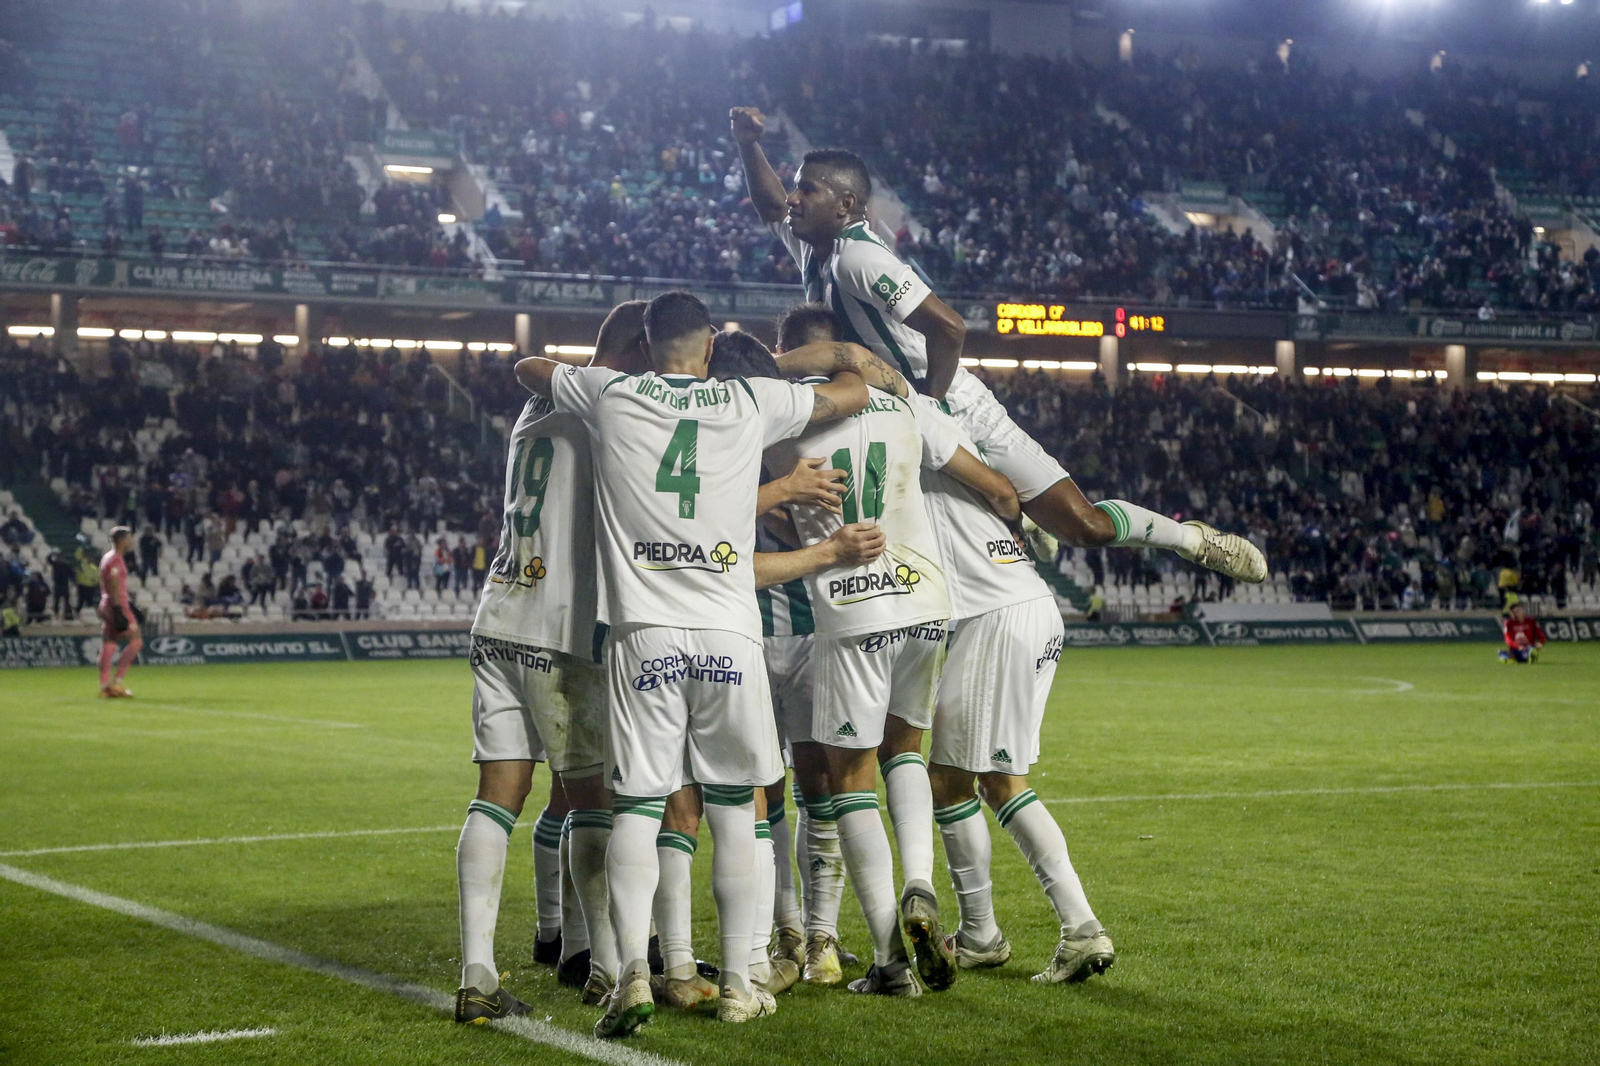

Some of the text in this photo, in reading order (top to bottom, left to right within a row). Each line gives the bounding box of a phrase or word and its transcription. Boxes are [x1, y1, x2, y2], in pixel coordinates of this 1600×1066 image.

[133, 266, 178, 280] CLUB
[533, 281, 604, 300] FAESA
[655, 418, 700, 519] 4
[357, 634, 414, 649] CLUB
[485, 647, 552, 674] HYUNDAI
[641, 654, 733, 673] CORHYUND
[663, 667, 742, 686] HYUNDAI
